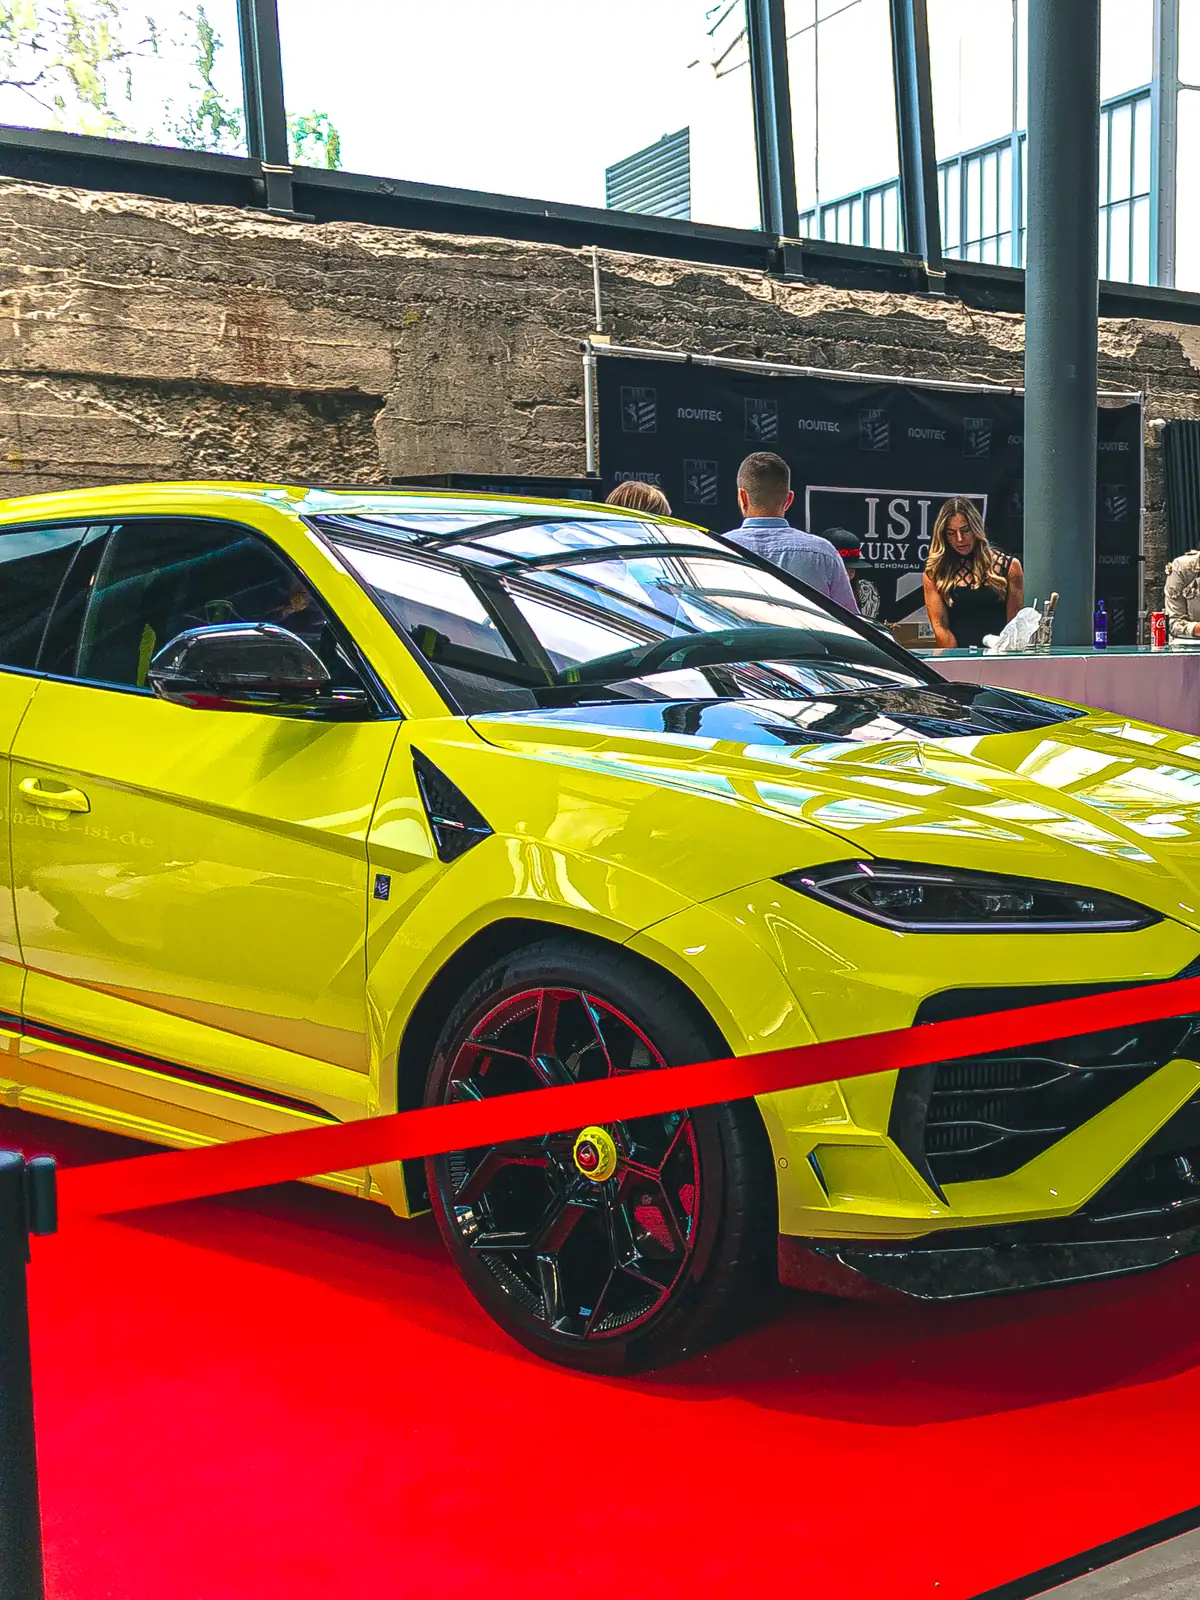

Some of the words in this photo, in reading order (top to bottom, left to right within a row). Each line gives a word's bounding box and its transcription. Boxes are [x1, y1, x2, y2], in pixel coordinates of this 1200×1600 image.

[677, 407, 722, 422] NOVITEC
[798, 419, 840, 432] NOVITEC
[908, 427, 947, 441] NOVITEC
[1098, 441, 1130, 451] OVITEC
[864, 498, 931, 540] ISI
[874, 562, 920, 570] SCHONGAU
